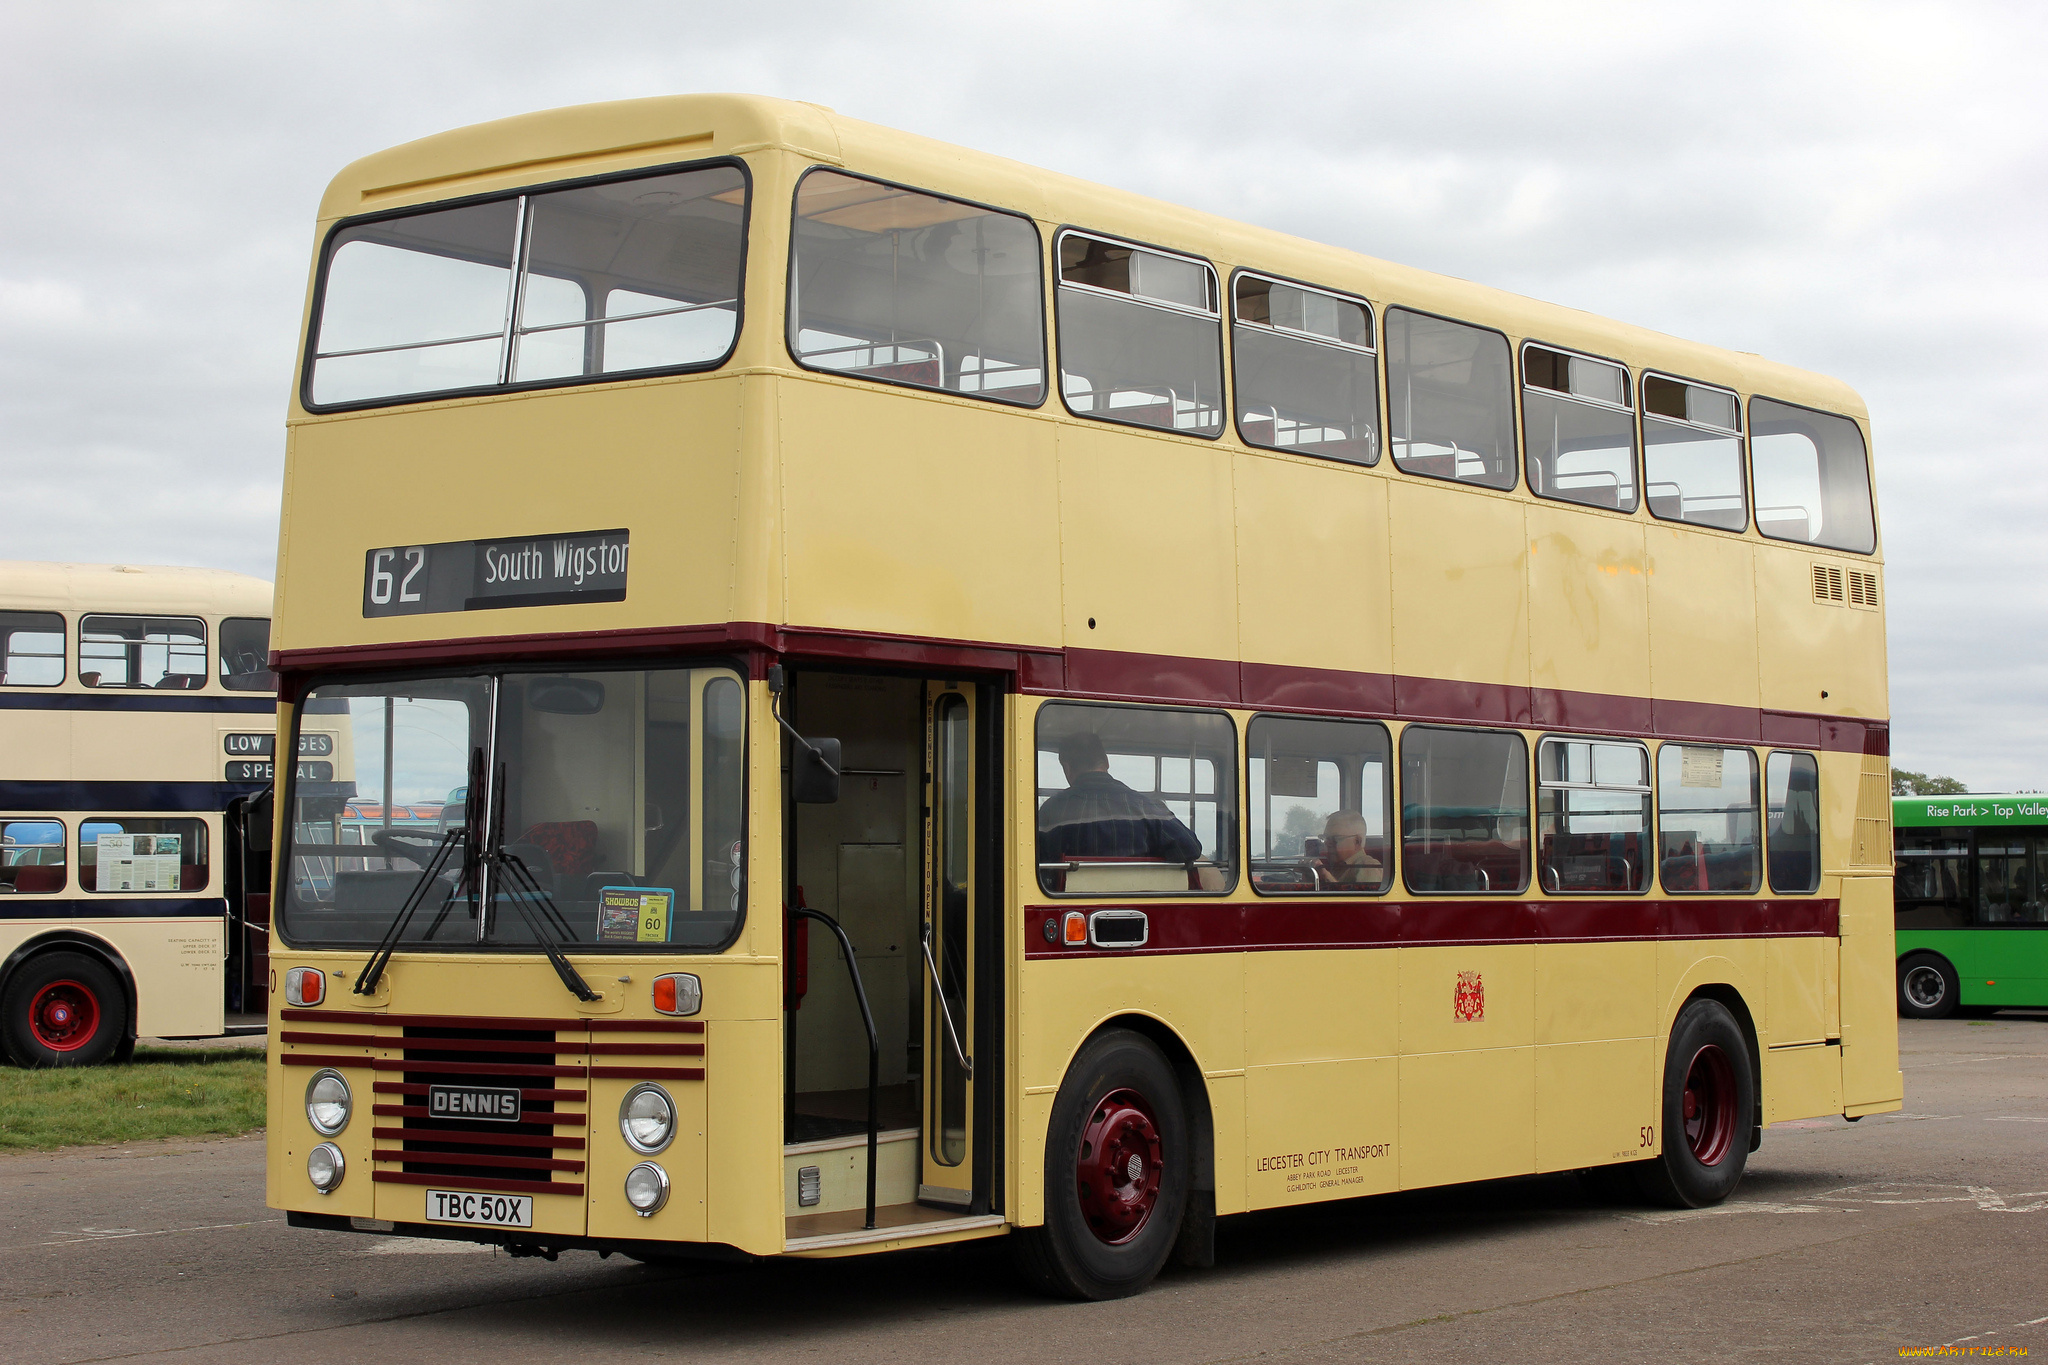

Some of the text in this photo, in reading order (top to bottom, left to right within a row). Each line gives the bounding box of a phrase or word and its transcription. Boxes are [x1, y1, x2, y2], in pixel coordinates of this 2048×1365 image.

[485, 541, 543, 584] South
[370, 546, 425, 605] 62
[230, 736, 262, 751] LOW
[242, 763, 317, 779] SPEAL
[1927, 804, 1949, 817] Rise
[1953, 803, 1977, 817] Park
[1992, 803, 2014, 819] Top
[645, 918, 661, 930] 60
[433, 1091, 516, 1115] DENNIS
[1640, 1126, 1653, 1147] 50
[1256, 1143, 1390, 1172] LEICESTER CITY TRANSPORT
[1287, 1166, 1359, 1182] ABBEY PARK ROAD LEICESTER
[1319, 1179, 1340, 1189] GENERAL
[1341, 1175, 1364, 1185] MANAGER
[435, 1193, 522, 1223] TBC 50X
